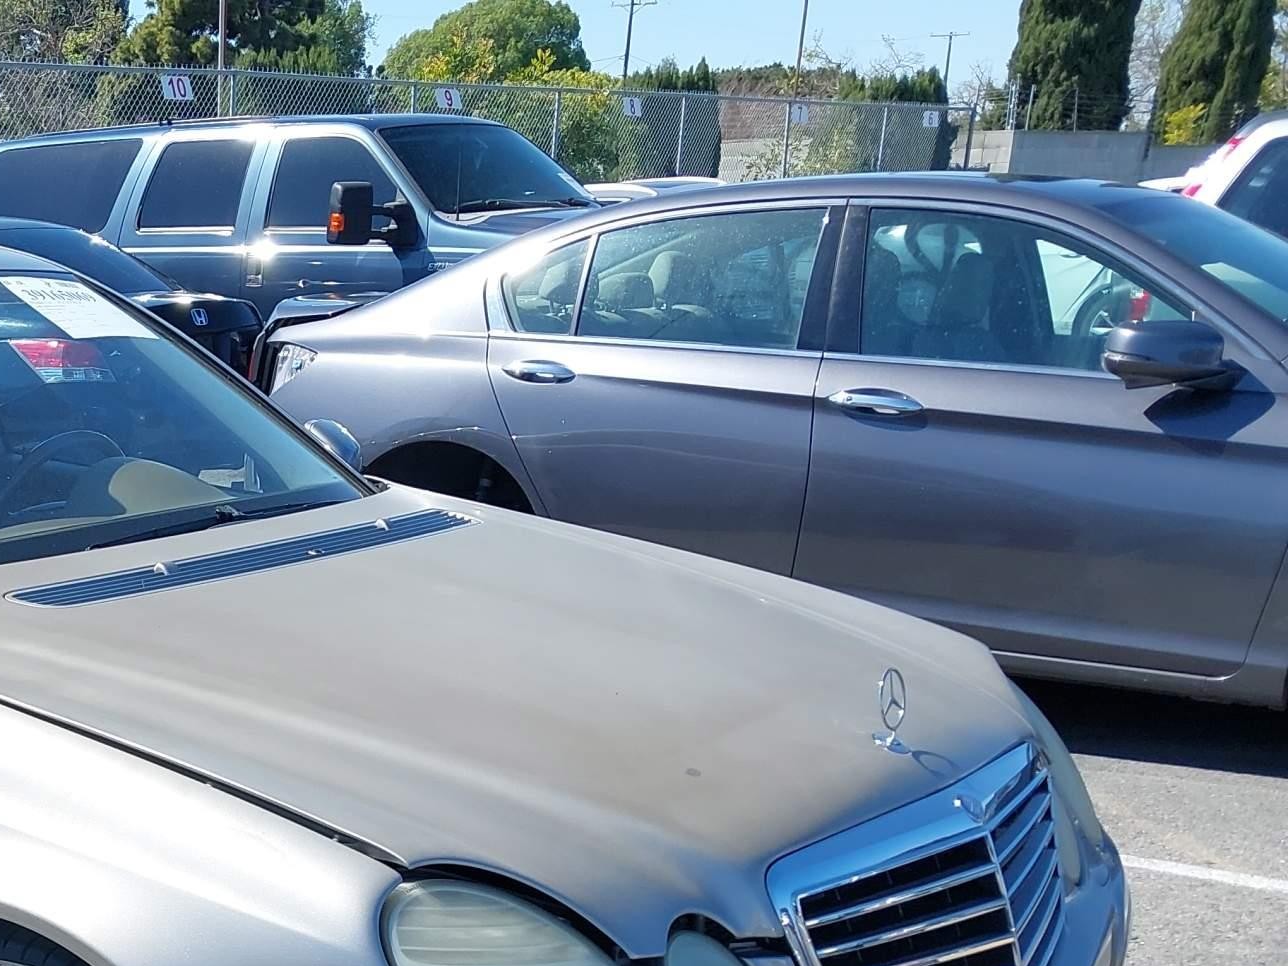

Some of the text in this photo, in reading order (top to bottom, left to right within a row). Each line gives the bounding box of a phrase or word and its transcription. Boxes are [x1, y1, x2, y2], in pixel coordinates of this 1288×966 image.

[168, 77, 187, 98] 10
[444, 90, 453, 107] 9
[629, 98, 636, 115] 8
[928, 112, 934, 126] 6
